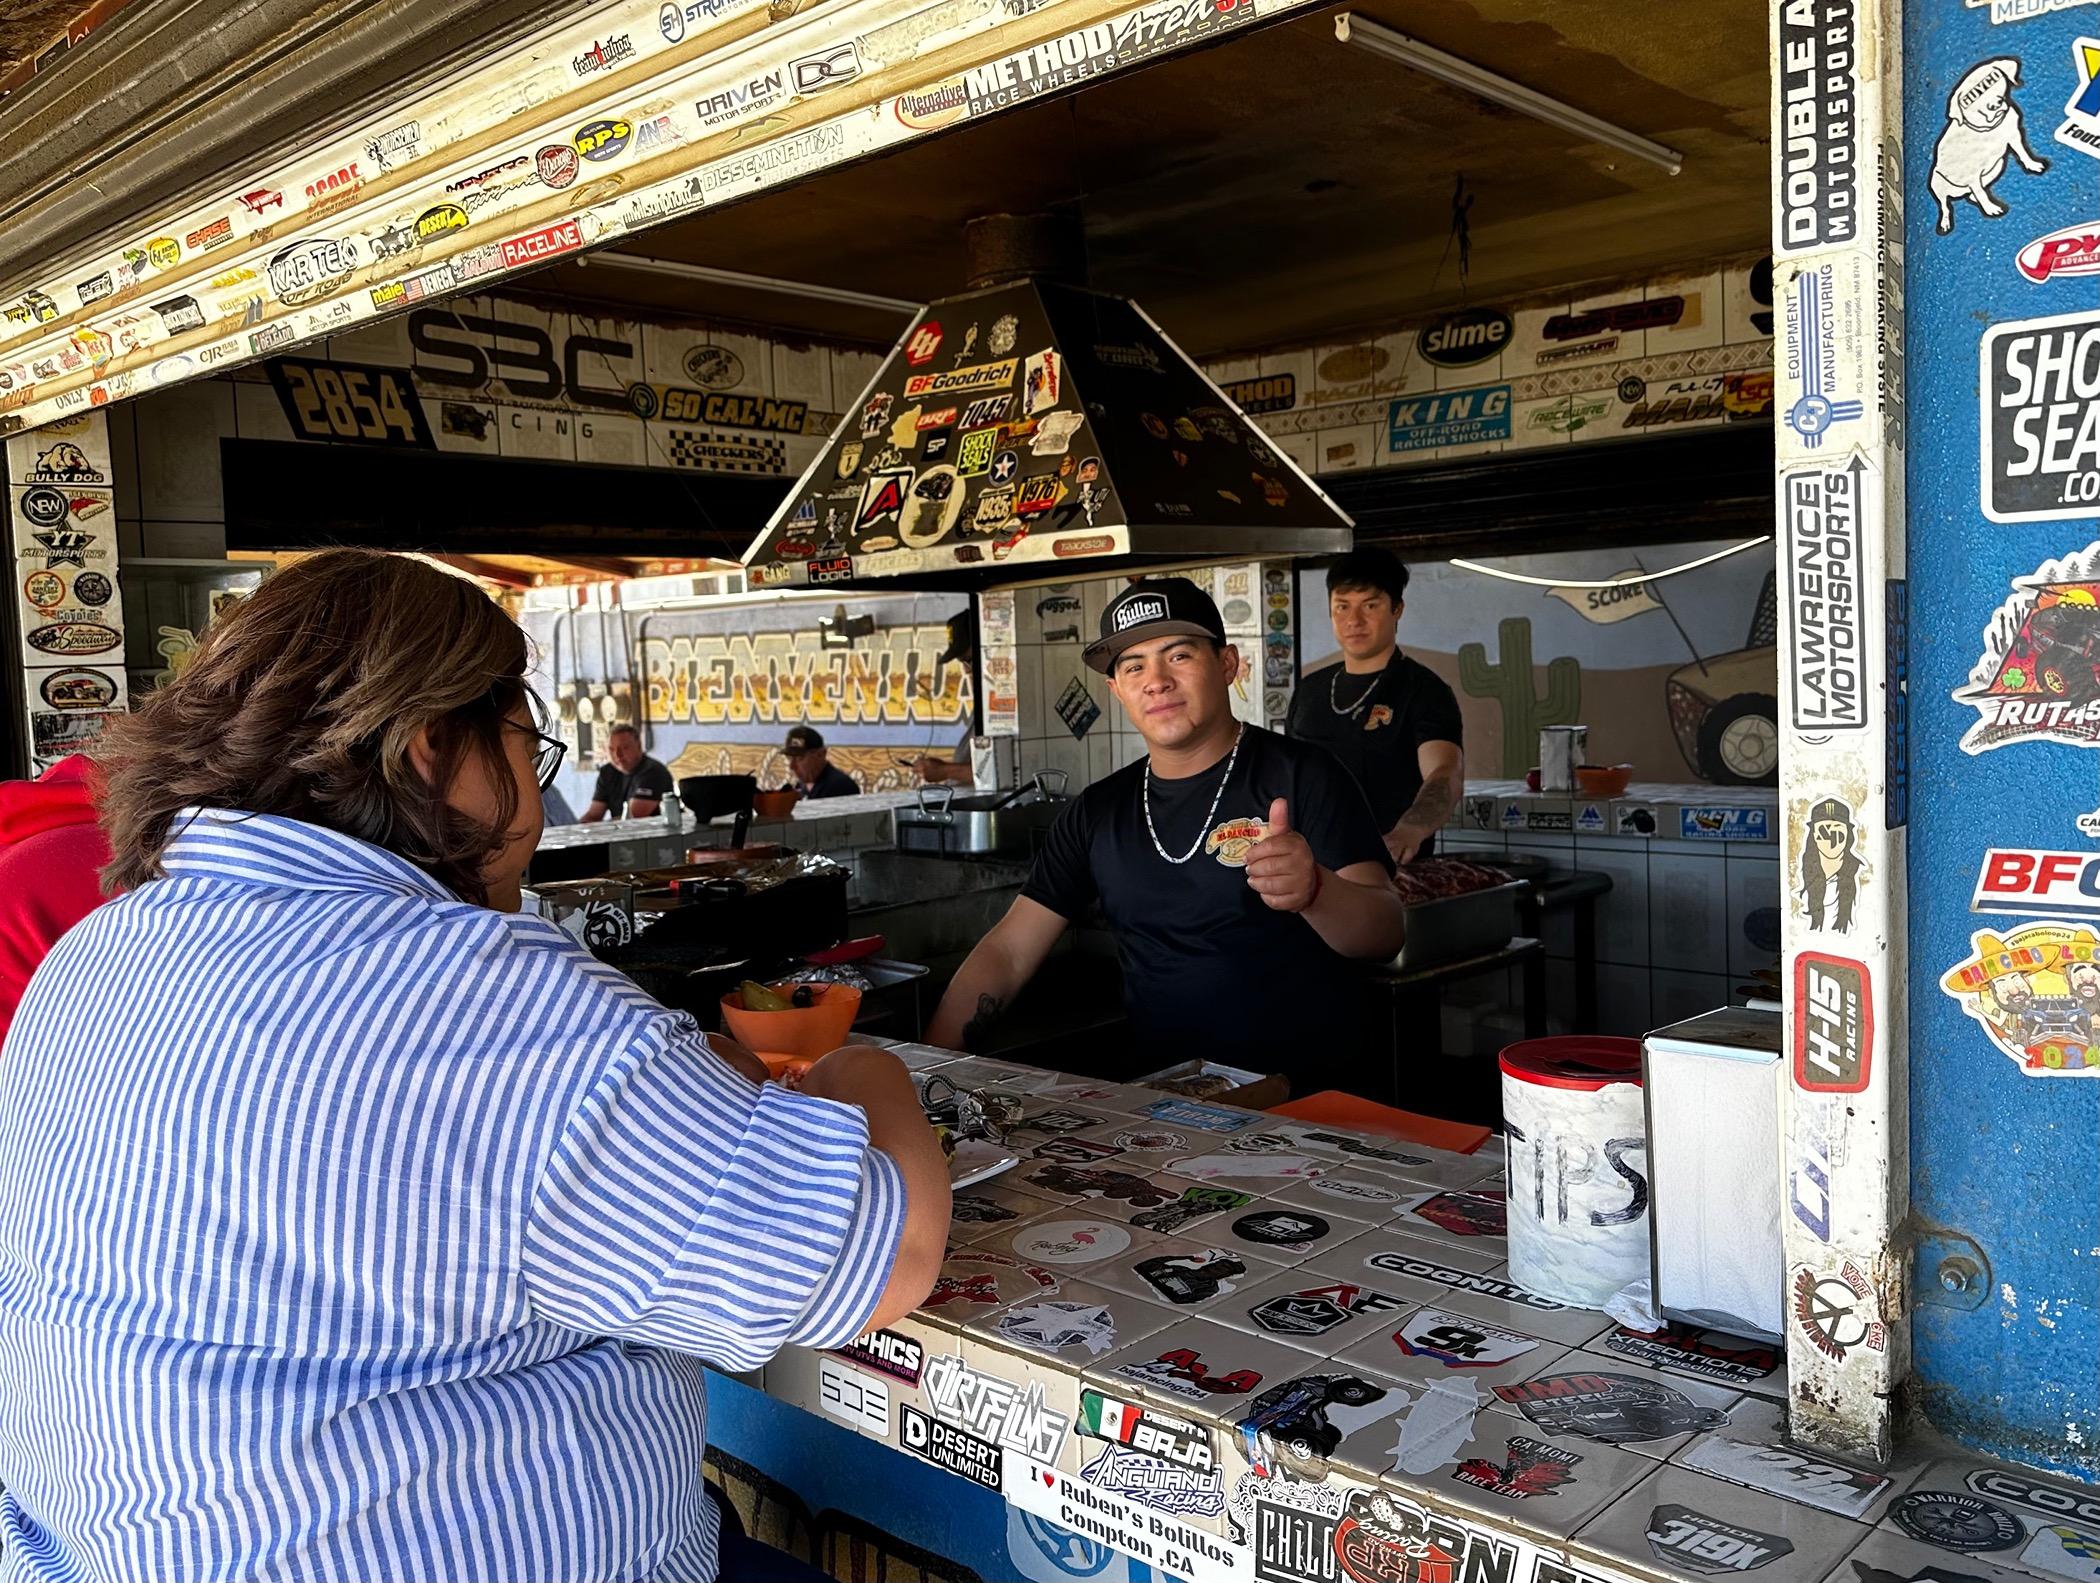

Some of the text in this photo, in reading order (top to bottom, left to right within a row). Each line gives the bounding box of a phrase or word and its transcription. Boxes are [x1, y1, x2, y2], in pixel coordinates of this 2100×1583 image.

[968, 23, 1117, 100] METHOD
[695, 71, 784, 119] DRIVEN
[901, 83, 965, 114] Alternative
[972, 54, 1117, 115] RACE WHEELS
[704, 104, 740, 127] MOTOR
[577, 122, 630, 155] RPS
[1786, 37, 1818, 244] DOUBLE
[187, 217, 232, 249] CHASE
[419, 209, 451, 237] DESERT
[505, 225, 579, 263] RACELINE
[2060, 253, 2100, 267] ADVANCE
[284, 287, 311, 304] OFF
[1426, 319, 1506, 354] slime
[1820, 263, 1836, 393] MANUFACTURING
[199, 345, 224, 364] CJR
[408, 308, 634, 412] SBC
[908, 365, 1012, 394] BFGoodrich
[1223, 377, 1292, 402] THOD
[54, 388, 84, 410] ONLY
[281, 363, 418, 442] 2854
[665, 390, 702, 421] SO
[1395, 390, 1506, 428] KING
[964, 433, 994, 453] SHOCK
[1394, 426, 1506, 450] RACING SHOCKS
[1410, 421, 1481, 439] OFF-ROAD
[693, 446, 766, 461] CHECKERS
[962, 450, 990, 469] SEALS
[26, 473, 104, 483] BULLY DOG
[29, 499, 60, 514] NEW
[20, 547, 108, 559] MOTORSPORTS
[51, 530, 86, 547] YT
[809, 558, 851, 573] FLUID
[809, 569, 853, 583] LOGIC
[1587, 584, 1643, 610] SCORE
[1795, 481, 1828, 718] LAWRENCE
[1824, 473, 1856, 721] MOTORSPORTS
[641, 630, 974, 724] BIENVENID
[1996, 699, 2100, 727] RUTAS
[1227, 828, 1261, 840] RANCHO
[1685, 809, 1765, 832] KNG
[1959, 946, 2044, 987] BAJA CABO
[1809, 967, 1841, 1076] H-15
[1847, 990, 1857, 1062] RACING
[1502, 1119, 1650, 1226] TIPS
[1378, 1252, 1559, 1308] COGNITO
[1795, 1269, 1816, 1291] FOR
[1841, 1261, 1873, 1300] VOTE
[1795, 1292, 1849, 1364] PRESIDENT
[848, 1330, 921, 1371] PHICS
[855, 1350, 916, 1379] UTVS AND MORE
[1607, 1333, 1766, 1379] XPEDITIONS
[1608, 1341, 1750, 1384] @bajaxpeditions
[1530, 1391, 1614, 1410] STEEL
[1143, 1411, 1195, 1435] DESERT
[931, 1423, 1000, 1469] DESERT
[1133, 1424, 1213, 1472] BAJA
[1538, 1444, 1580, 1464] MOMI
[932, 1443, 999, 1488] UNLIMITED
[1093, 1447, 1217, 1493] ANGUIANO
[1456, 1470, 1529, 1500] RACE TEAM
[1913, 1490, 1985, 1511] WARRIOR
[1030, 1465, 1235, 1568] I Ruben's Bolillos
[1060, 1503, 1153, 1560] Compton
[1681, 1514, 1764, 1544] HONDA
[1358, 1518, 1431, 1558] Racing
[1647, 1518, 1773, 1571] 319X
